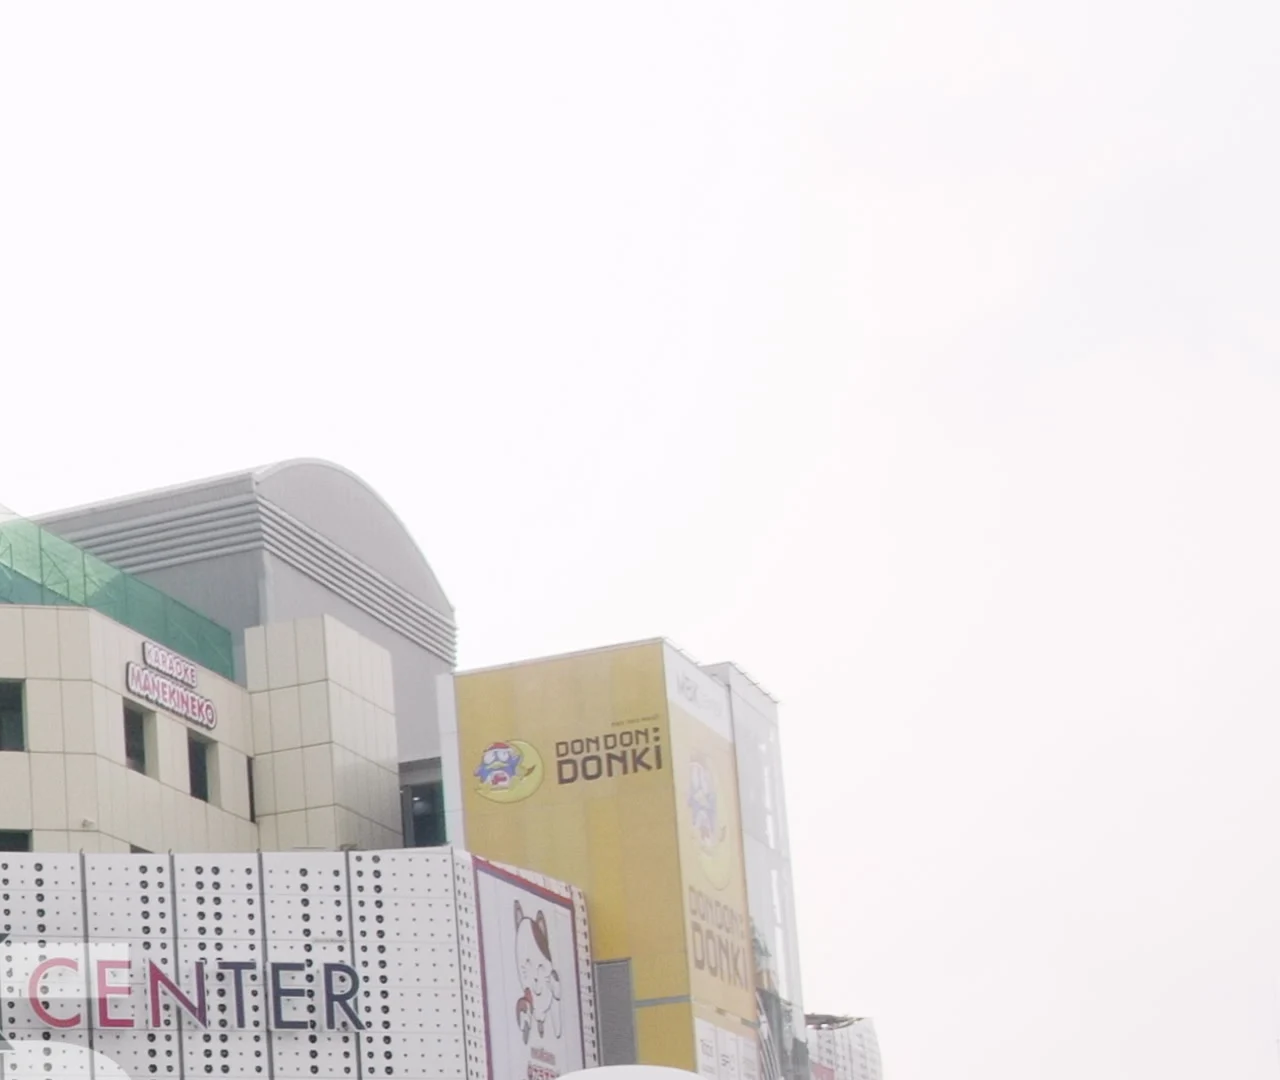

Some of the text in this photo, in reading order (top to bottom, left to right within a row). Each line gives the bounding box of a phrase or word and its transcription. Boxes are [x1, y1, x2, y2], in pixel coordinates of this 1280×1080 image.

[146, 643, 197, 687] KARAOKE
[130, 663, 216, 727] MANEKINEKO
[555, 735, 600, 758] DON
[556, 745, 663, 785] DONKI
[691, 920, 748, 992] DONKI
[27, 957, 366, 1031] CENTER
